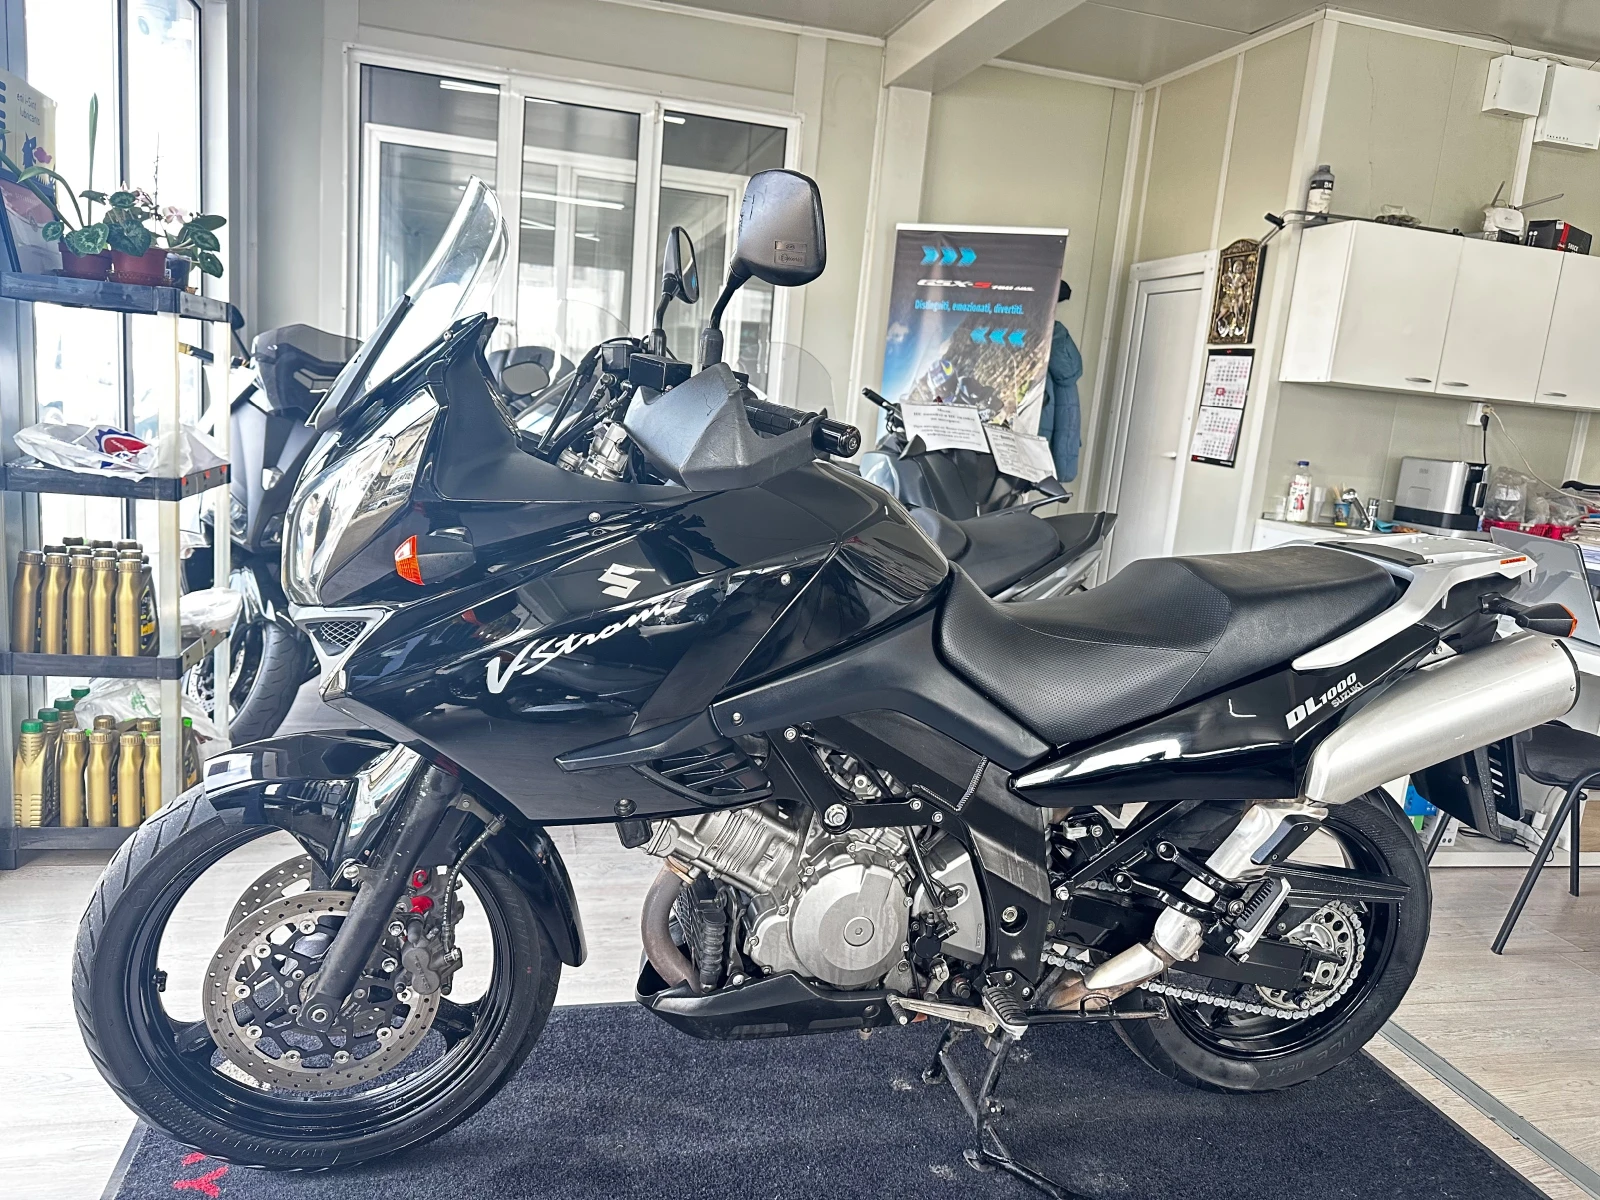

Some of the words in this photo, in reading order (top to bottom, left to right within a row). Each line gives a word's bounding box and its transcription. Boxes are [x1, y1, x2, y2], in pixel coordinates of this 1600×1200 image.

[993, 302, 1024, 315] divertiti.
[1285, 672, 1357, 730] DL1000
[1331, 681, 1364, 708] SUZUKI
